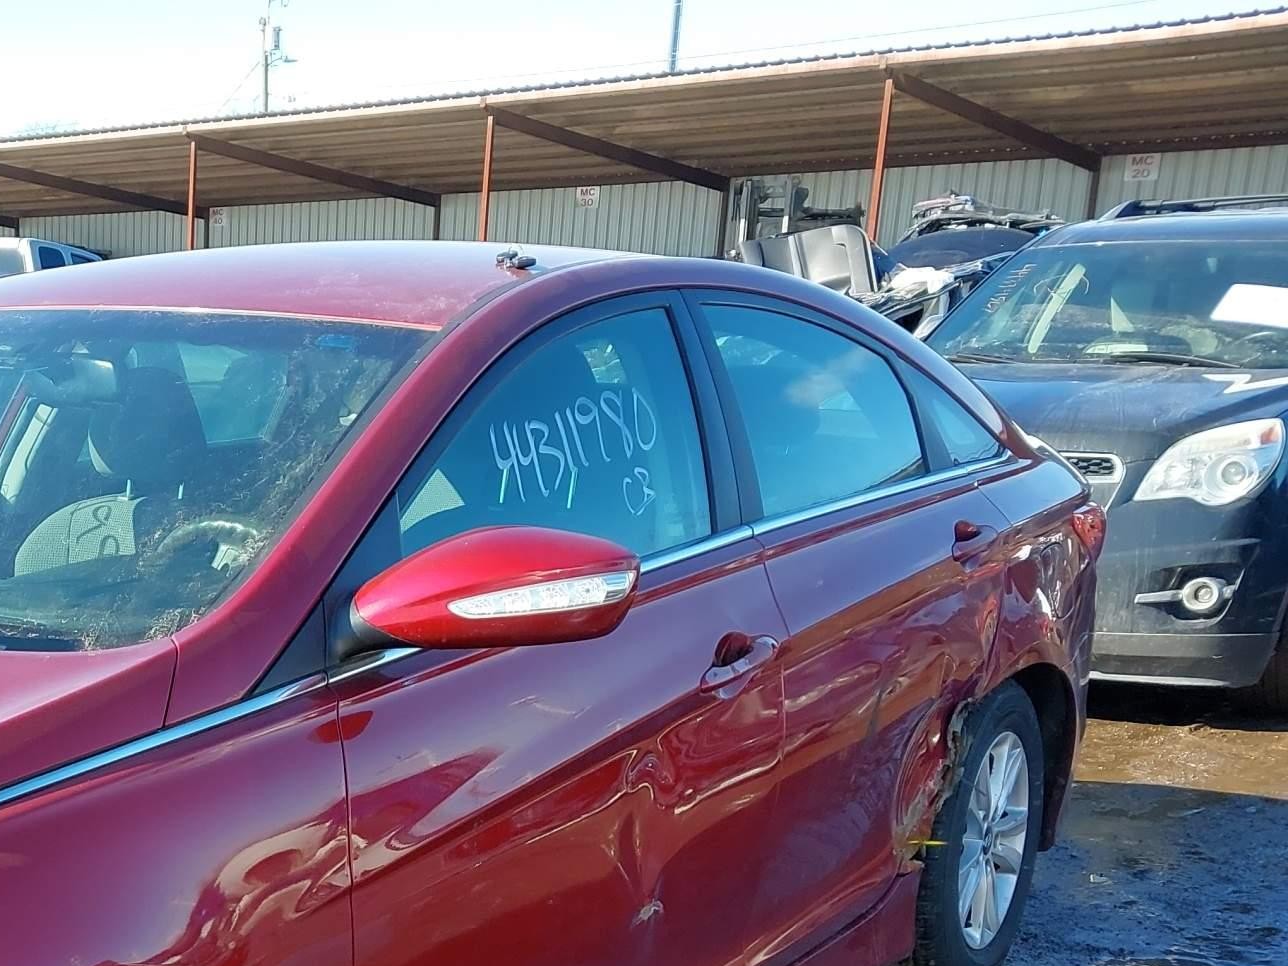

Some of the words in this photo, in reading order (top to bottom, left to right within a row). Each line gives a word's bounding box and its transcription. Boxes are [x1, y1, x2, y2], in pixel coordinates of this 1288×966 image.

[1131, 155, 1154, 166] MC
[1131, 169, 1151, 178] 20
[580, 188, 596, 197] MC
[580, 198, 594, 207] 30
[489, 387, 657, 508] 44311980
